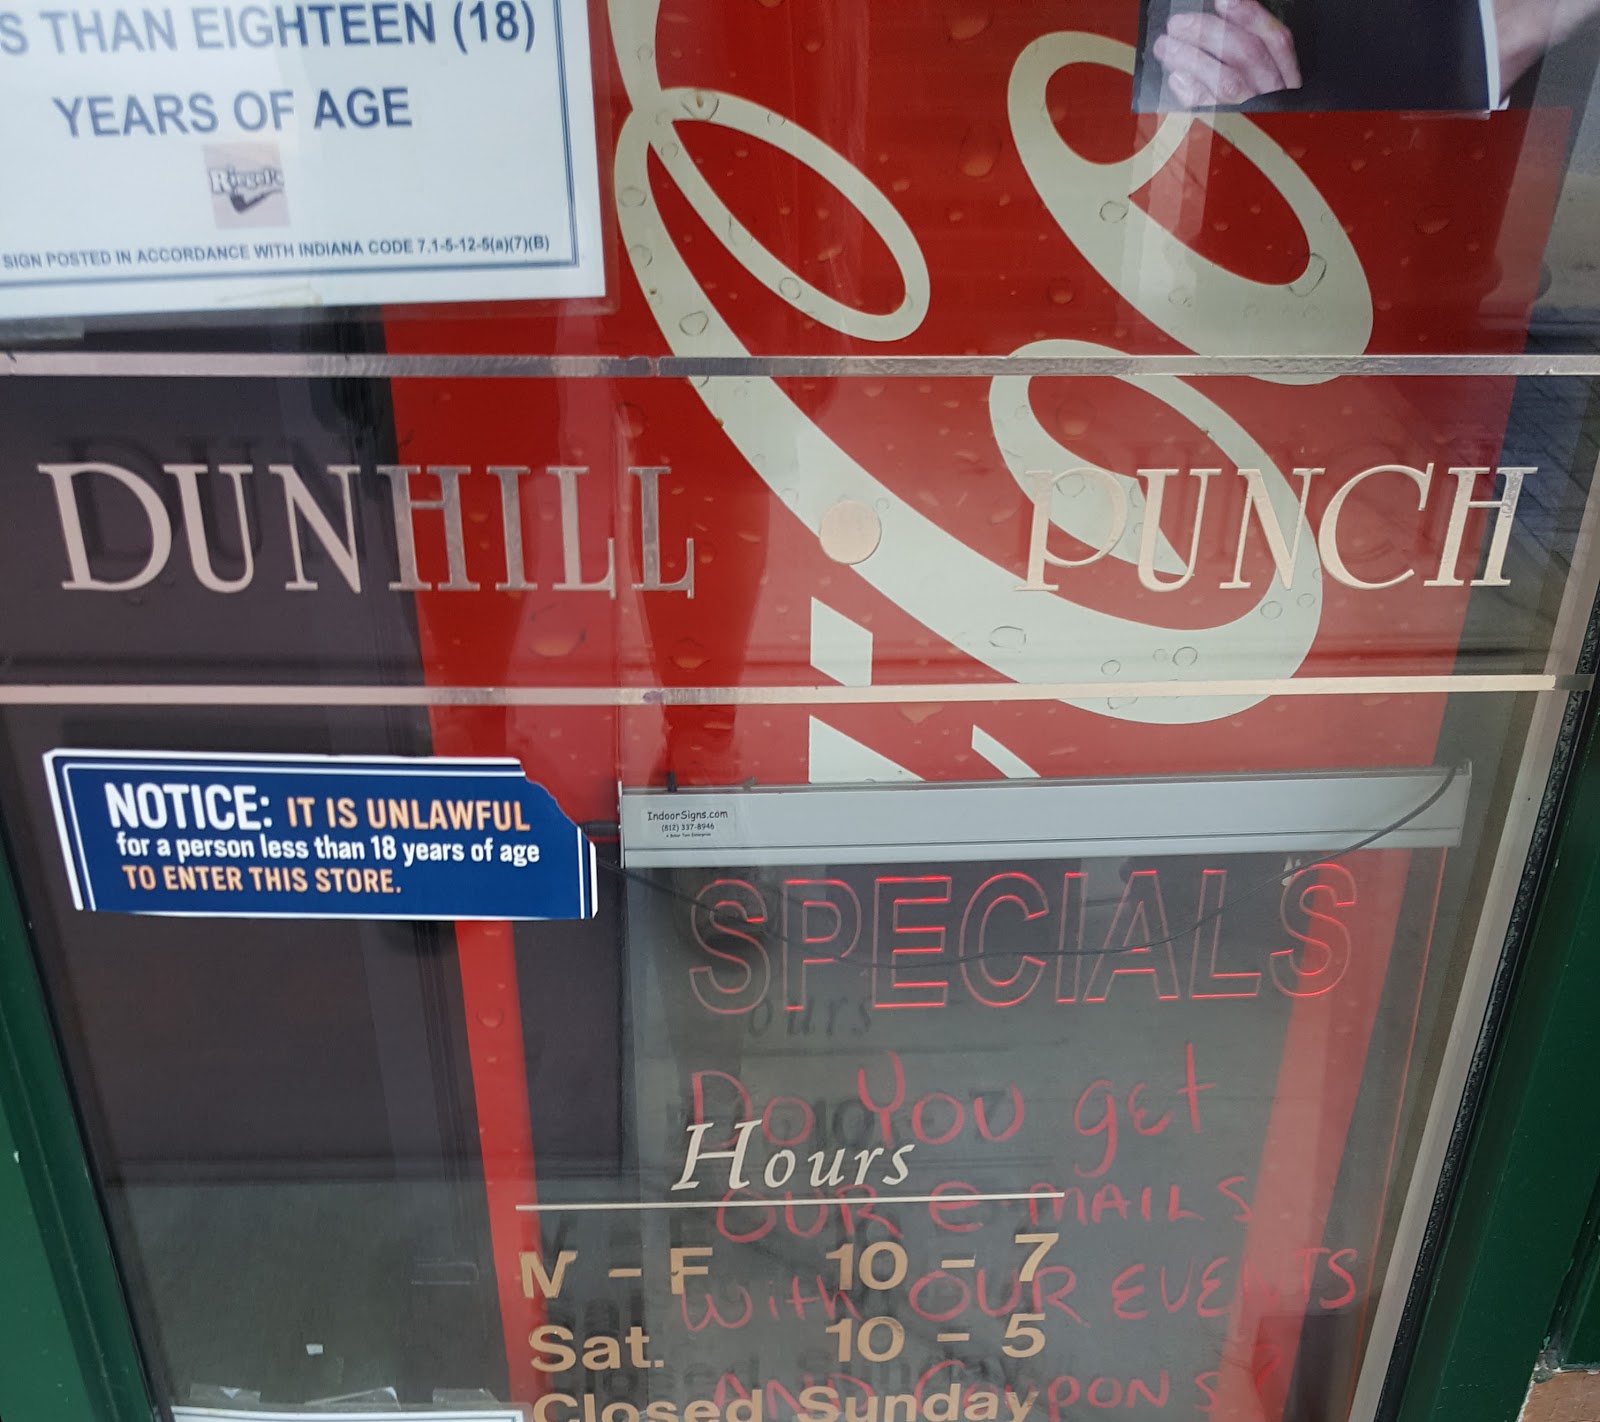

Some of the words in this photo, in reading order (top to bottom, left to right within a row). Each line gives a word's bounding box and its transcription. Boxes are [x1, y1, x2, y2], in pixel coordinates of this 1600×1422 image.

[40, 8, 178, 54] THAN
[191, 1, 437, 51] EIGHTEEN
[453, 0, 536, 54] (18)
[53, 94, 219, 138] YEARS
[233, 89, 295, 132] OF
[313, 86, 412, 129] AGE
[3, 253, 43, 270] SIGN
[48, 250, 112, 268] POSTED
[116, 249, 132, 265] IN
[137, 243, 250, 265] ACCORDANCE
[254, 243, 294, 260] WITH
[299, 240, 364, 258] INDIANA
[368, 239, 412, 256] CODE
[37, 462, 695, 600] DUNHILL
[1013, 461, 1540, 595] PUNCH
[104, 783, 272, 831] NOTICE:
[286, 797, 315, 828] IT
[327, 798, 359, 829] IS
[367, 799, 532, 832] UNLAWFUL
[647, 810, 728, 822] IndoorSigns.com
[661, 824, 680, 832] (812)
[116, 832, 150, 858] for
[156, 838, 171, 859] a
[177, 837, 256, 864] person
[260, 835, 310, 861] less
[314, 836, 366, 862] than
[370, 836, 398, 862] 18
[402, 843, 465, 868] years
[471, 839, 494, 862] of
[499, 844, 541, 868] age
[122, 864, 156, 892] TO
[163, 865, 244, 893] ENTER
[248, 866, 309, 894] THIS
[315, 868, 402, 896] STORE.
[688, 863, 1357, 1015] SPECIALS
[670, 1119, 915, 1191] Hours
[670, 1247, 713, 1295] F
[825, 1240, 909, 1292] 10
[1014, 1232, 1060, 1283] 7
[528, 1325, 665, 1373] Sat.
[825, 1315, 906, 1364] 10
[1001, 1313, 1047, 1359] 5
